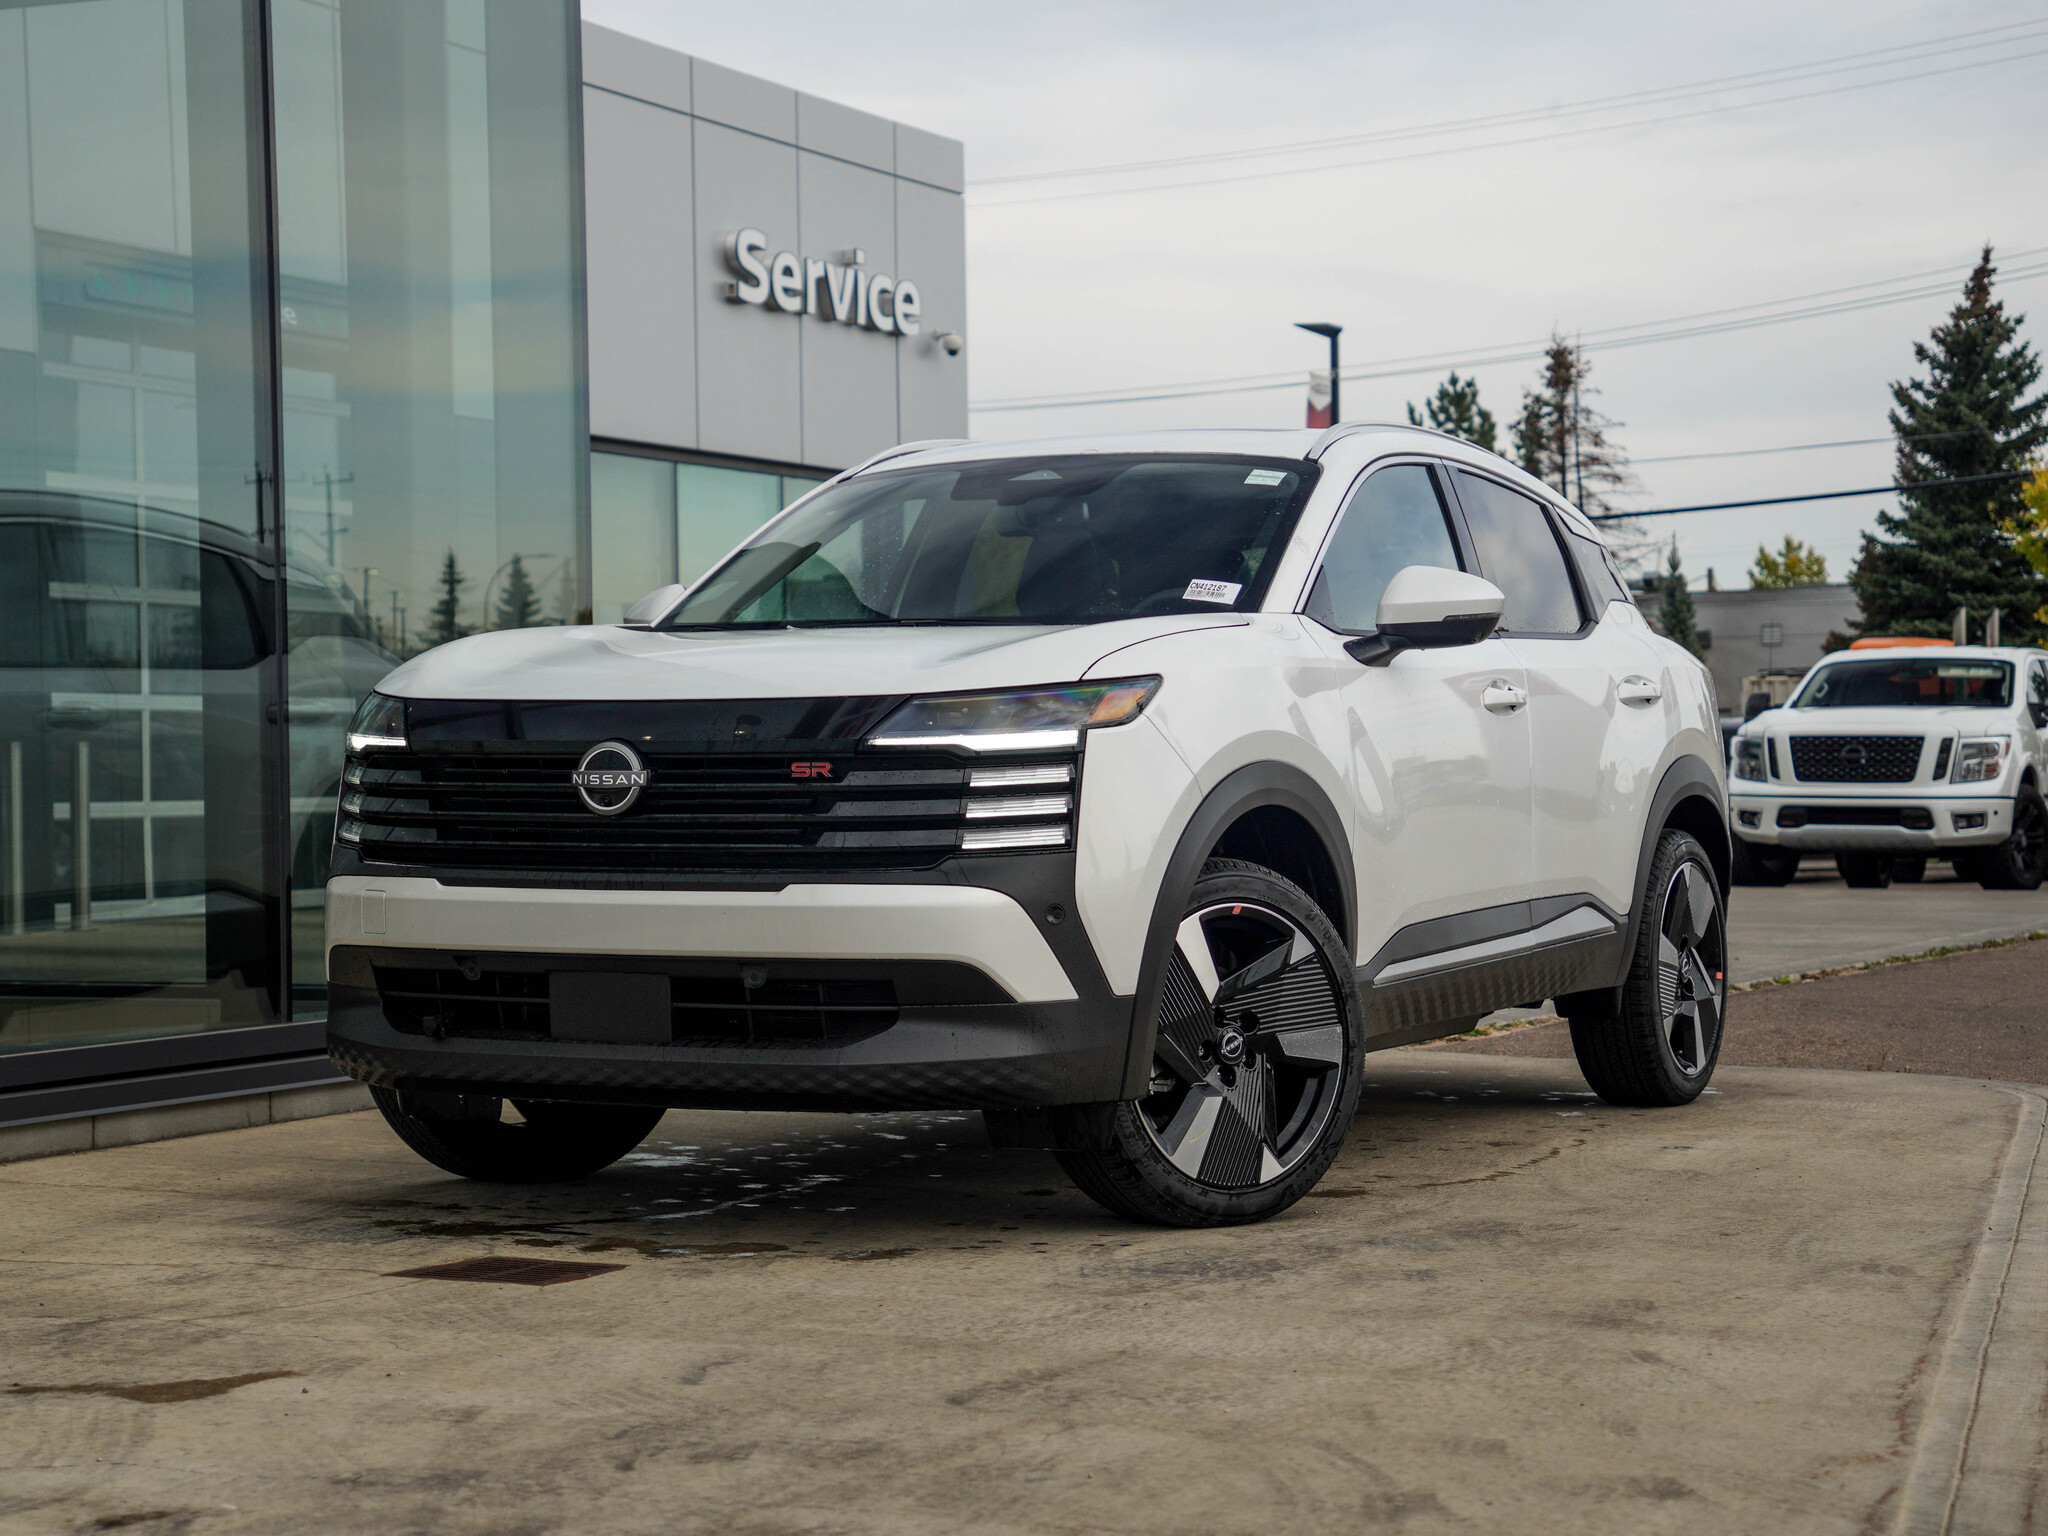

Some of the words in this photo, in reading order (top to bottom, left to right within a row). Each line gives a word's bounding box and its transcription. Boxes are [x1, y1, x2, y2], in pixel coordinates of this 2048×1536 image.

[734, 227, 921, 336] Service
[791, 762, 832, 777] SR
[572, 773, 645, 785] NISSAN
